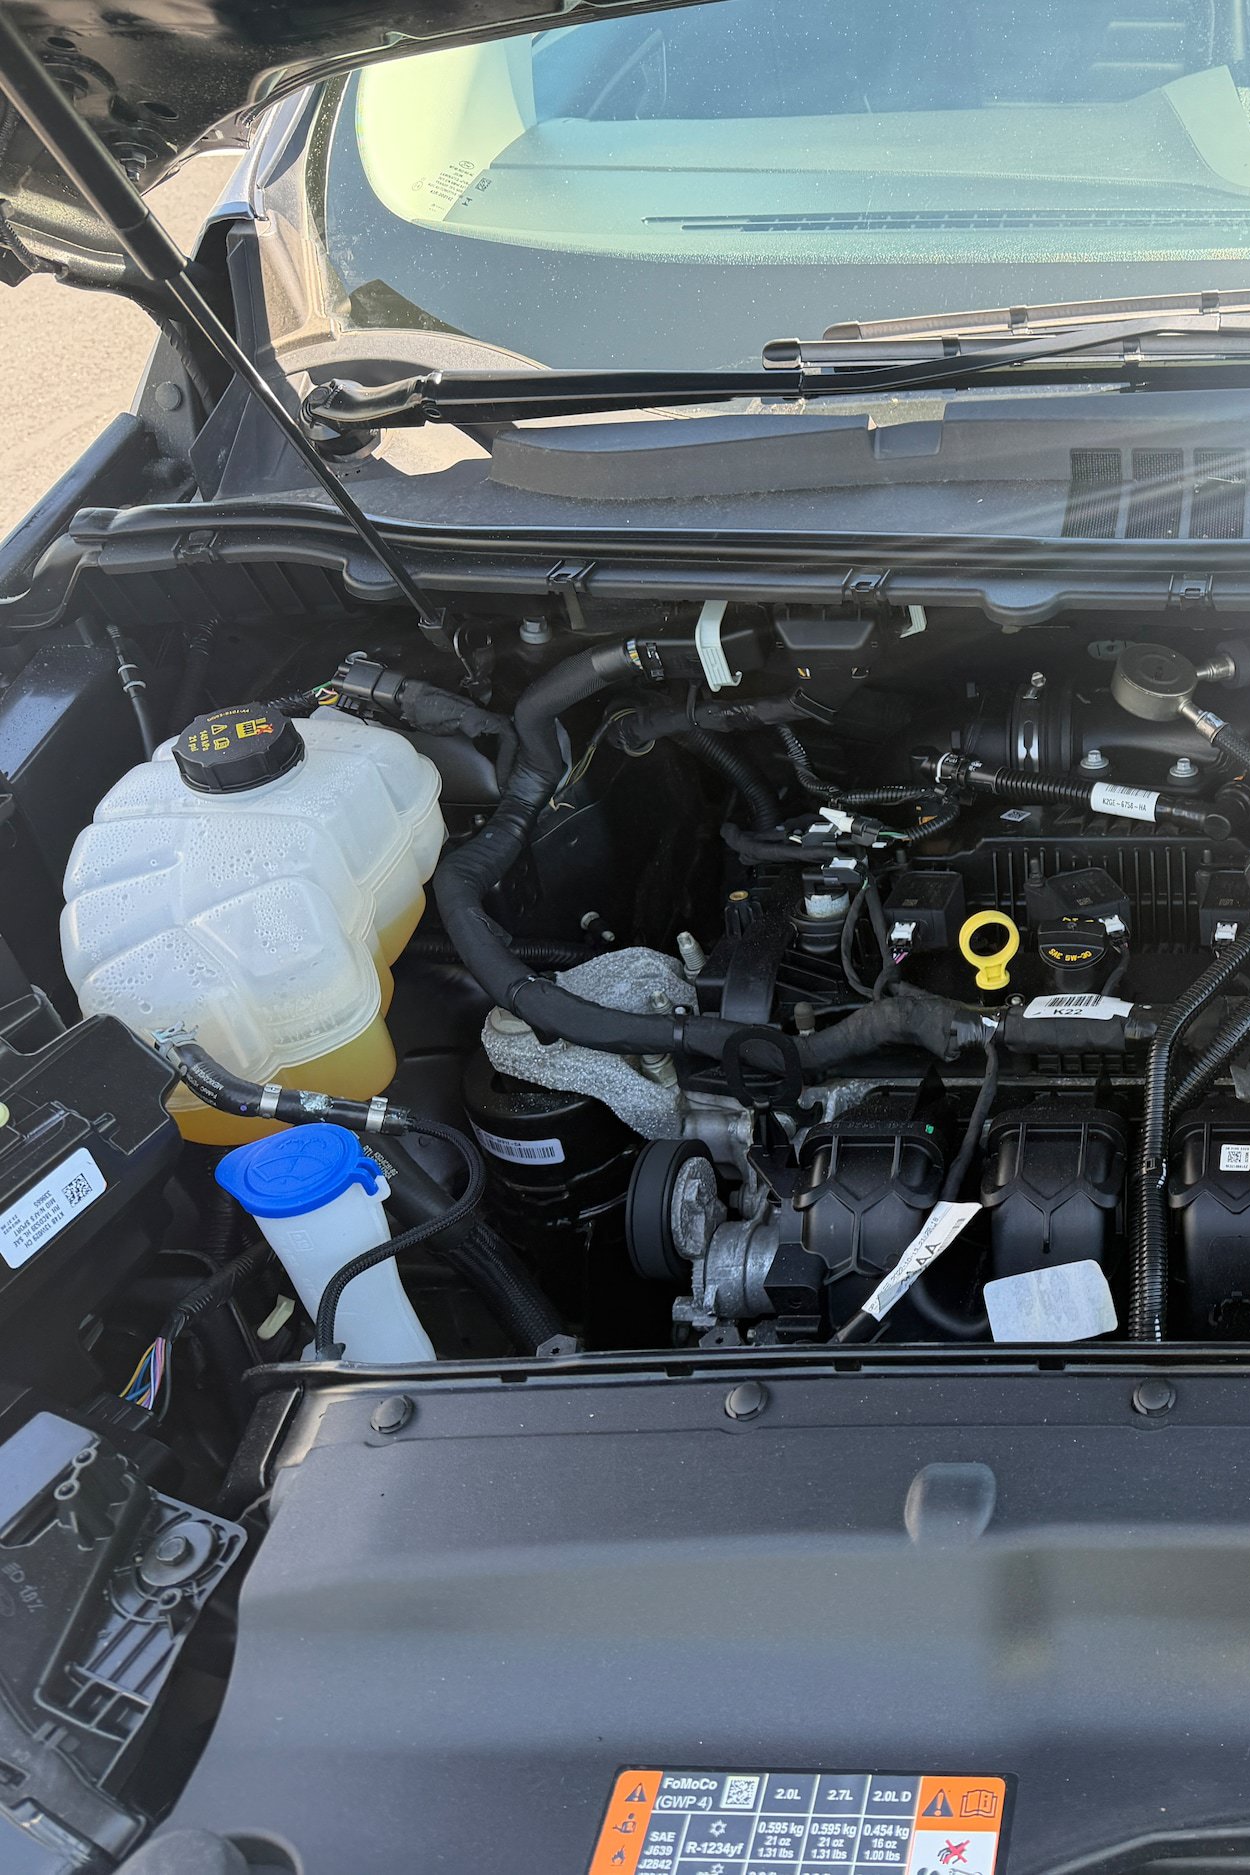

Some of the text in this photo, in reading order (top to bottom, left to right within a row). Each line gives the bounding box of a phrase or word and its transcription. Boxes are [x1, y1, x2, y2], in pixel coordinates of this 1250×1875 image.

[1048, 948, 1092, 962] SAE 5W-30
[1053, 1008, 1083, 1016] K22
[663, 1777, 718, 1791] FoMoCo
[776, 1788, 801, 1800] 2.0L
[827, 1789, 853, 1801] 2.7L
[873, 1790, 912, 1802] 2.0L D
[655, 1795, 713, 1811] (GWP 4)
[759, 1823, 804, 1838] 0.595 kg
[810, 1824, 857, 1838] 0.595 kg
[864, 1825, 909, 1839] 0.454 kg
[649, 1831, 676, 1842] SAE
[764, 1836, 791, 1847] 21 oz
[819, 1837, 845, 1848] 21 oz
[871, 1838, 897, 1849] 16 oz
[644, 1846, 673, 1856] J639
[686, 1842, 743, 1857] R-1234yf
[758, 1848, 794, 1859] 1.31 lbs
[811, 1849, 848, 1860] 1.31 lbs
[865, 1850, 900, 1861] 1.00 lbs
[638, 1860, 672, 1870] J2842
